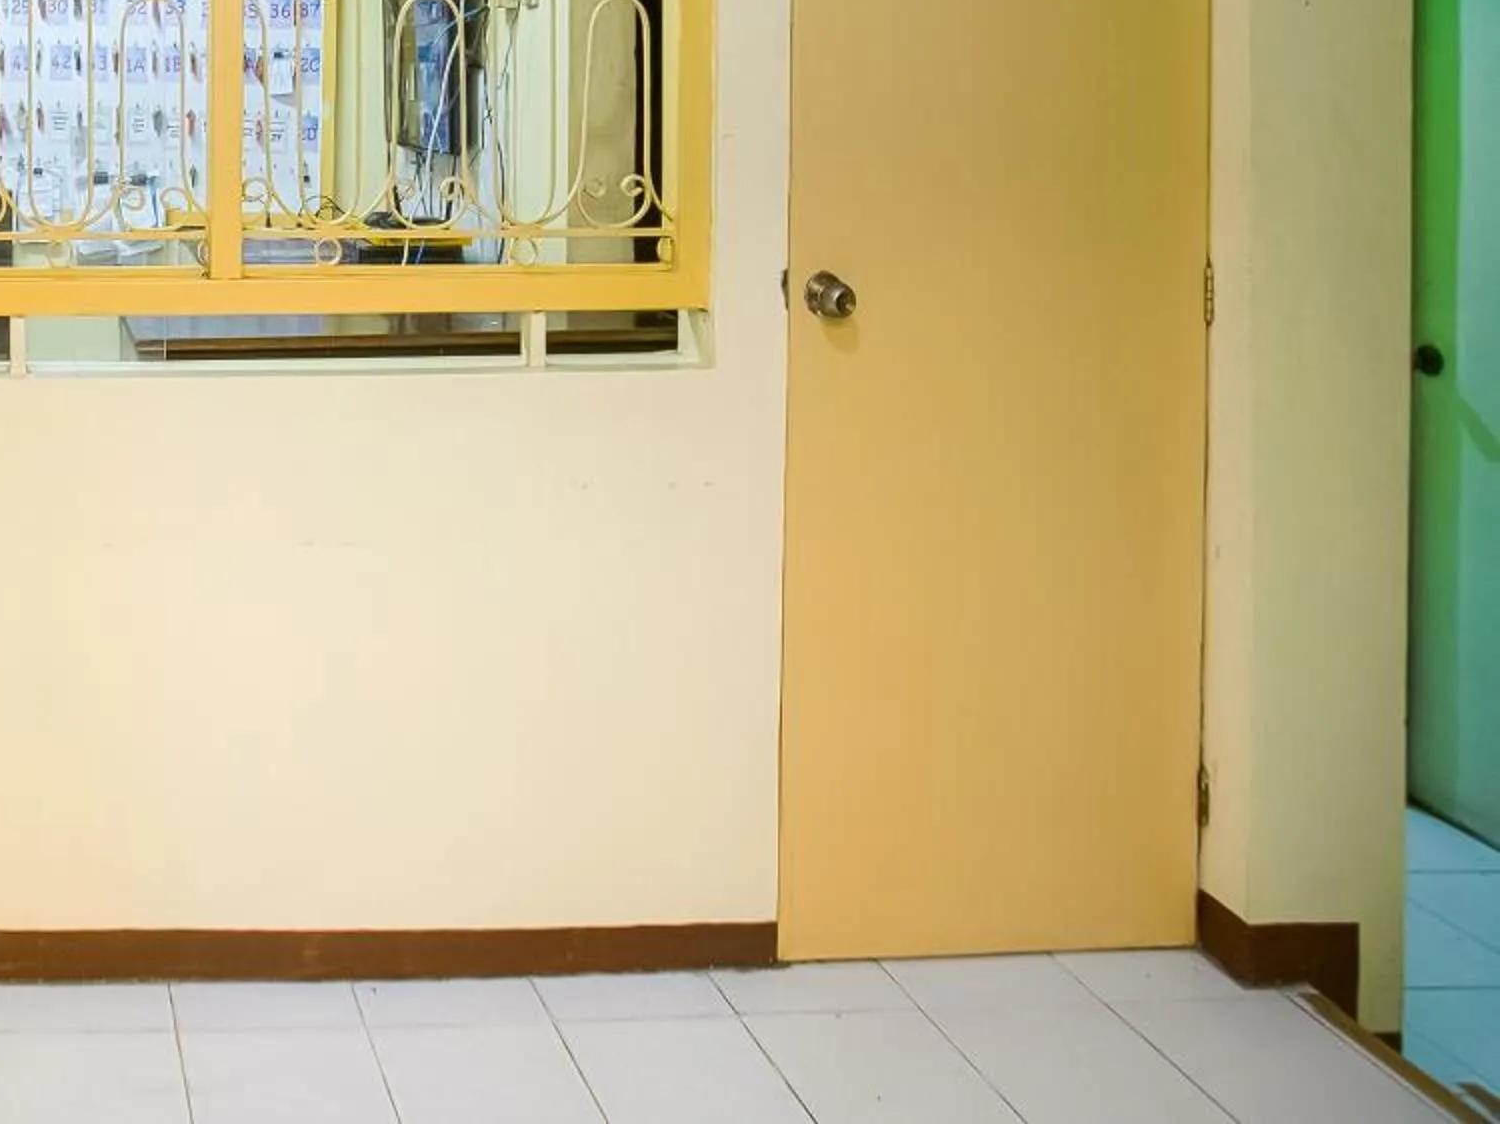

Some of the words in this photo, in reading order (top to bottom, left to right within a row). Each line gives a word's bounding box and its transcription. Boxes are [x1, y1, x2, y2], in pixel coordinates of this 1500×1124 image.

[270, 3, 291, 19] 36
[51, 54, 71, 71] 42
[126, 58, 146, 74] 1A
